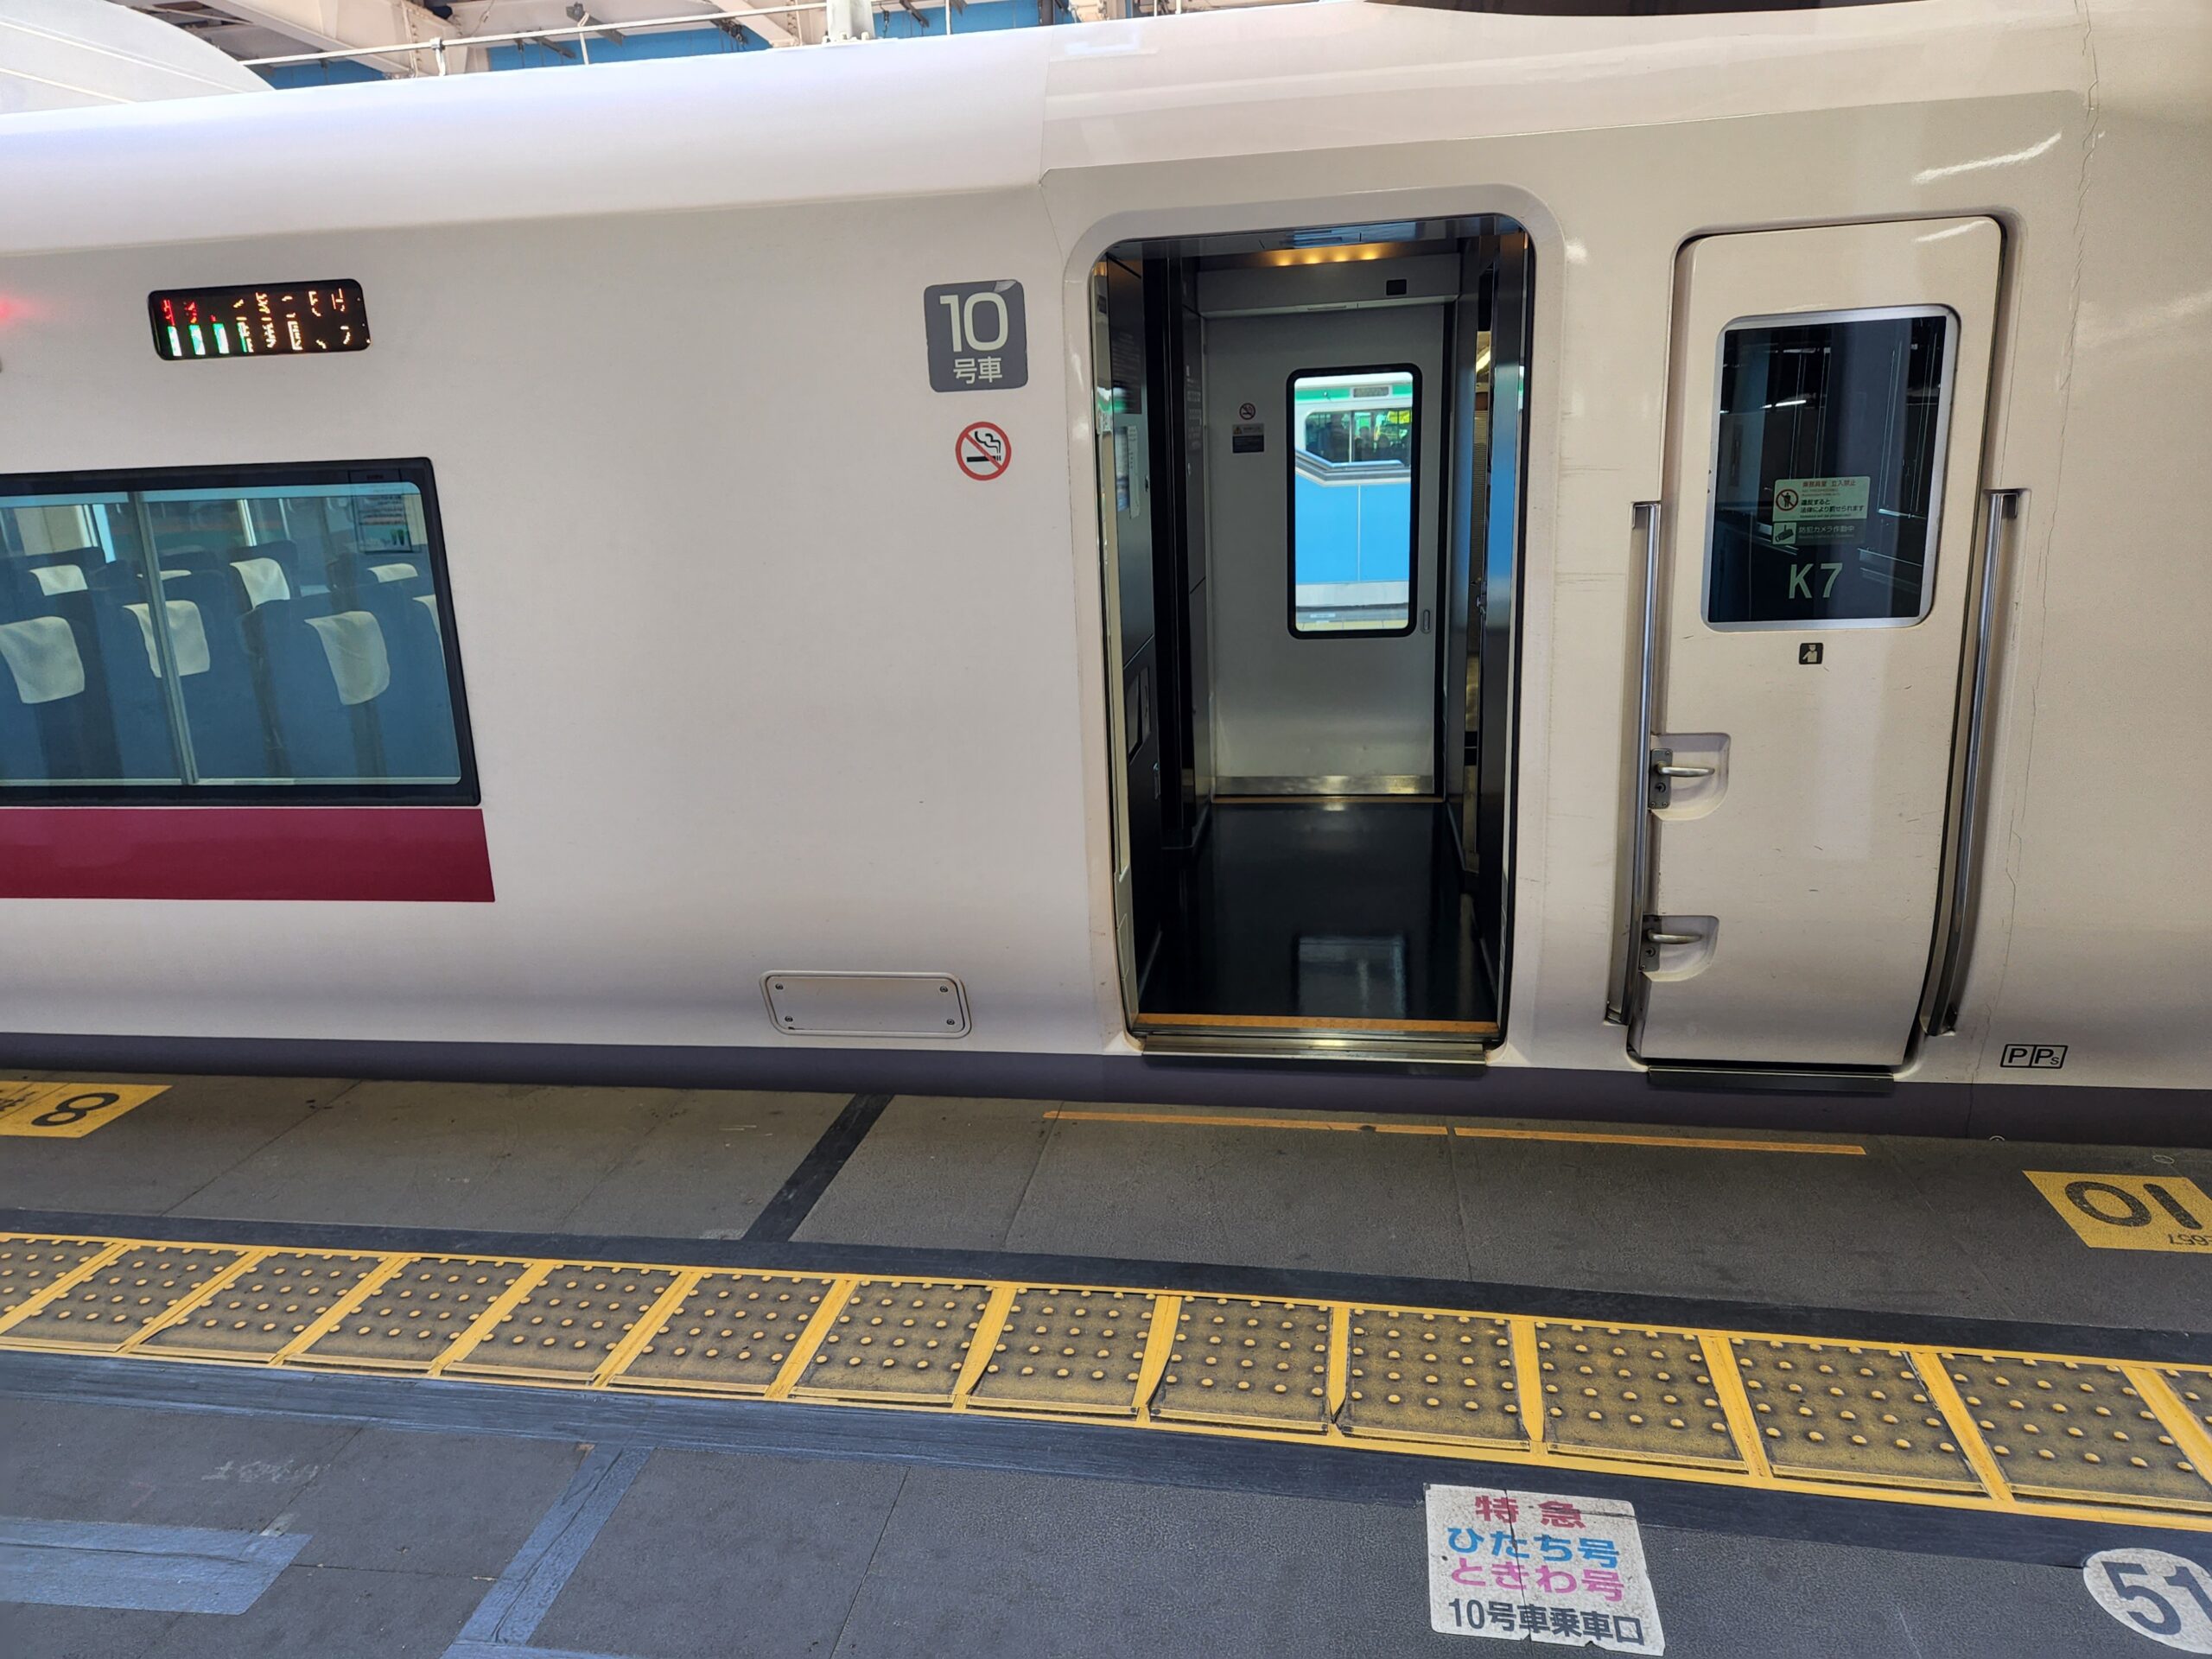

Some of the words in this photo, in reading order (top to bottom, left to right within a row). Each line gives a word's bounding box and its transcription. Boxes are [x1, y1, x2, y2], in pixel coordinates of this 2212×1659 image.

[939, 291, 1008, 353] 10
[953, 356, 1003, 384] 号車
[1788, 562, 1843, 600] K7
[31, 1092, 120, 1127] 8
[1474, 1495, 1586, 1529] 特急
[1446, 1527, 1619, 1569] ひたち号
[1452, 1557, 1624, 1602] ときわ号
[2101, 1560, 2212, 1636] 51
[1448, 1598, 1646, 1646] 10号車乗車口
